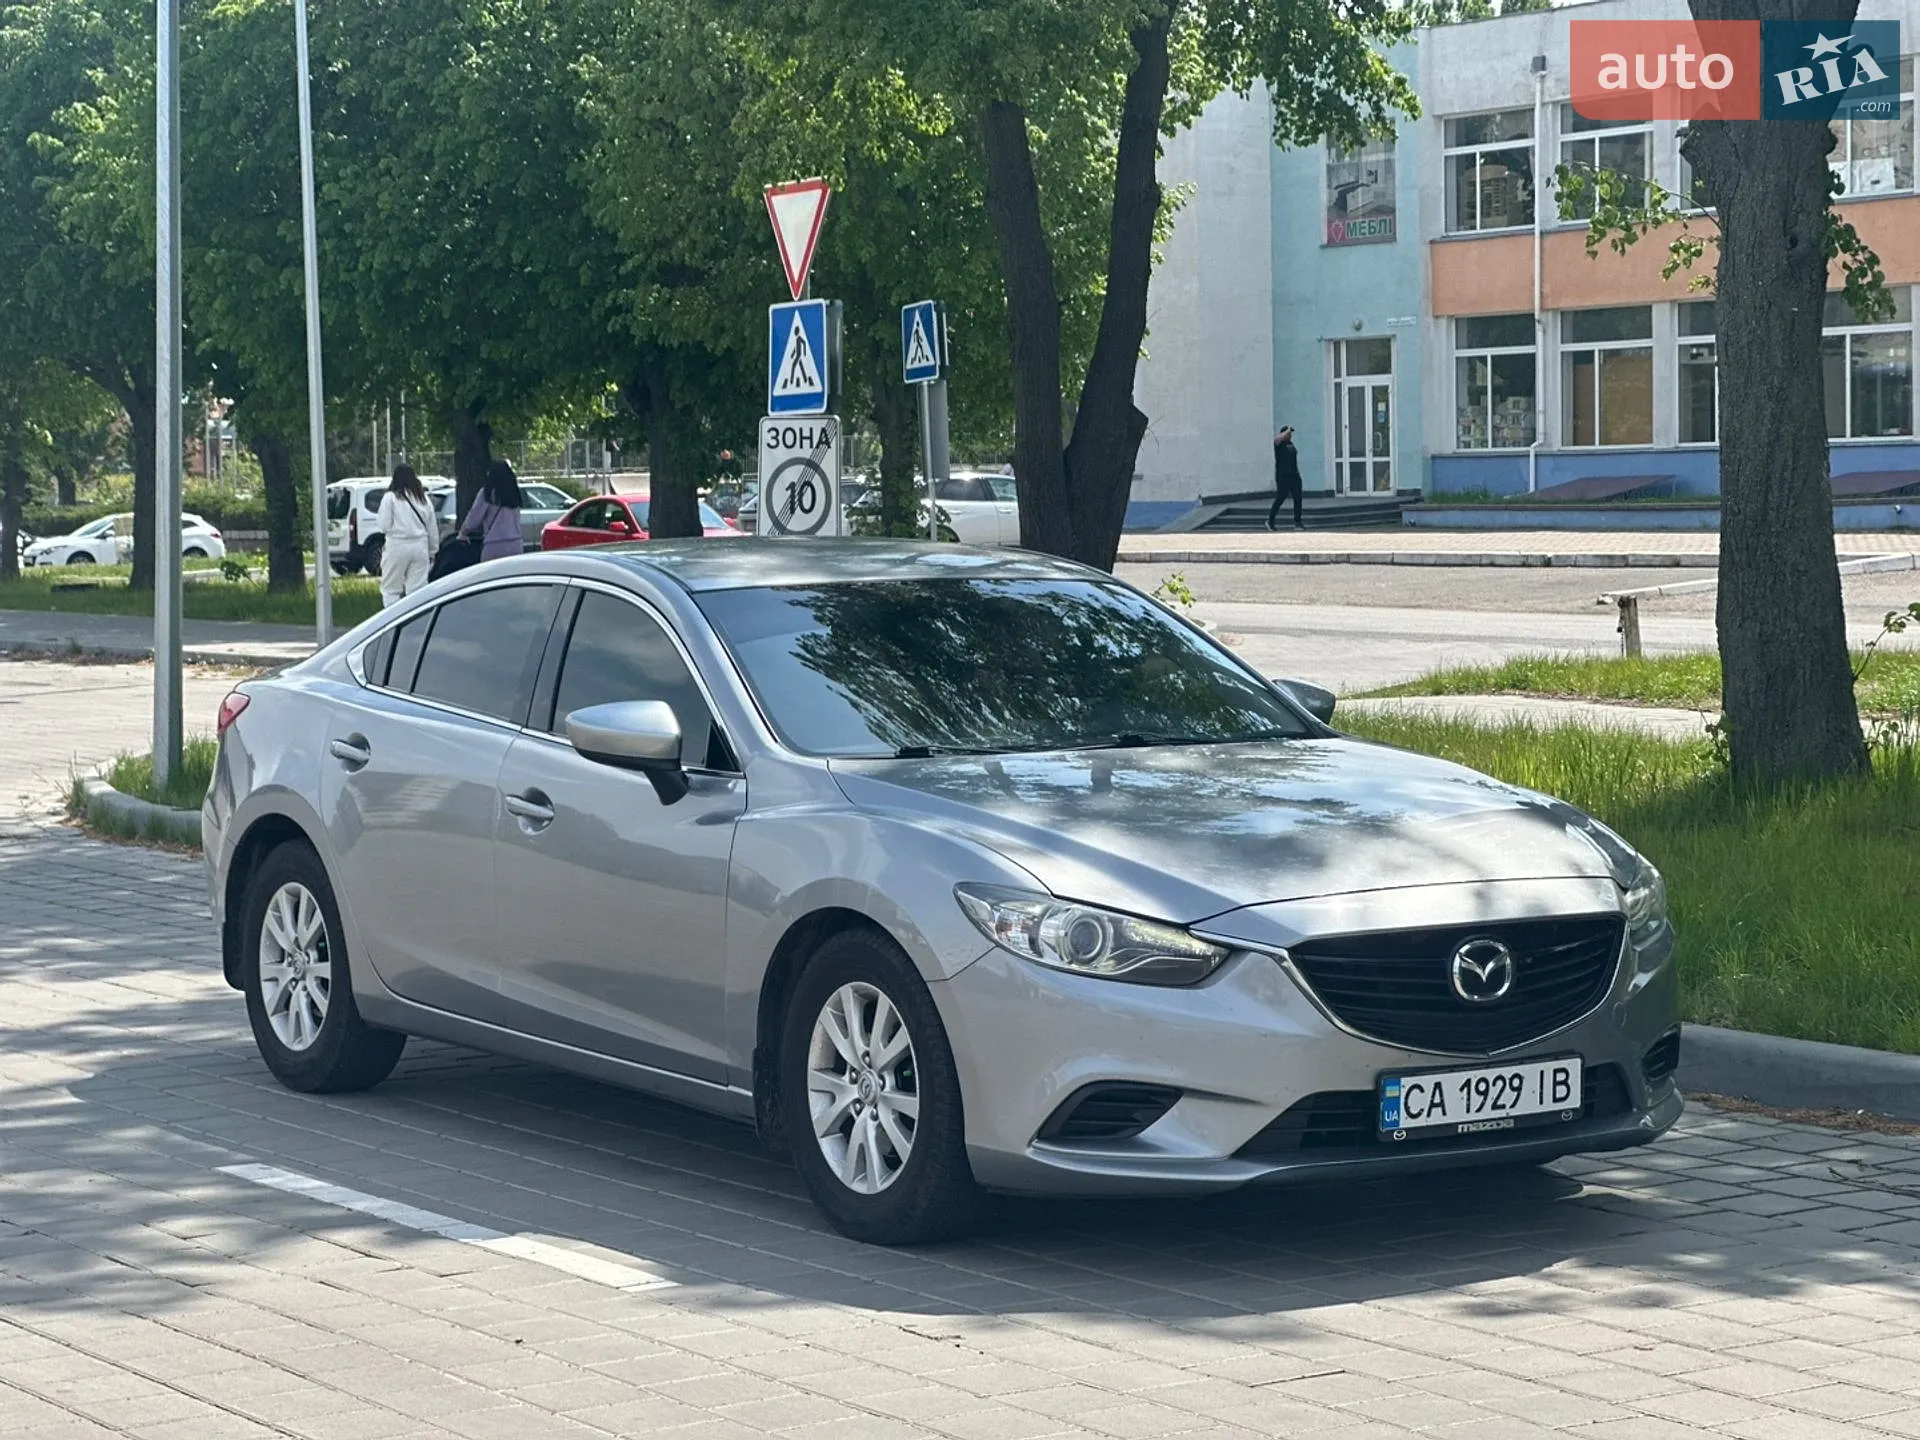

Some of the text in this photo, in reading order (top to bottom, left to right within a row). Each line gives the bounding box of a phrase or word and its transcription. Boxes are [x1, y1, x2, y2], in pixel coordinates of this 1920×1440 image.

[1346, 217, 1393, 238] МЕБЛІ
[766, 427, 832, 450] ЗОНА
[785, 480, 817, 515] 10
[1403, 1067, 1571, 1120] CA 1929 IB
[1384, 1110, 1400, 1123] UA
